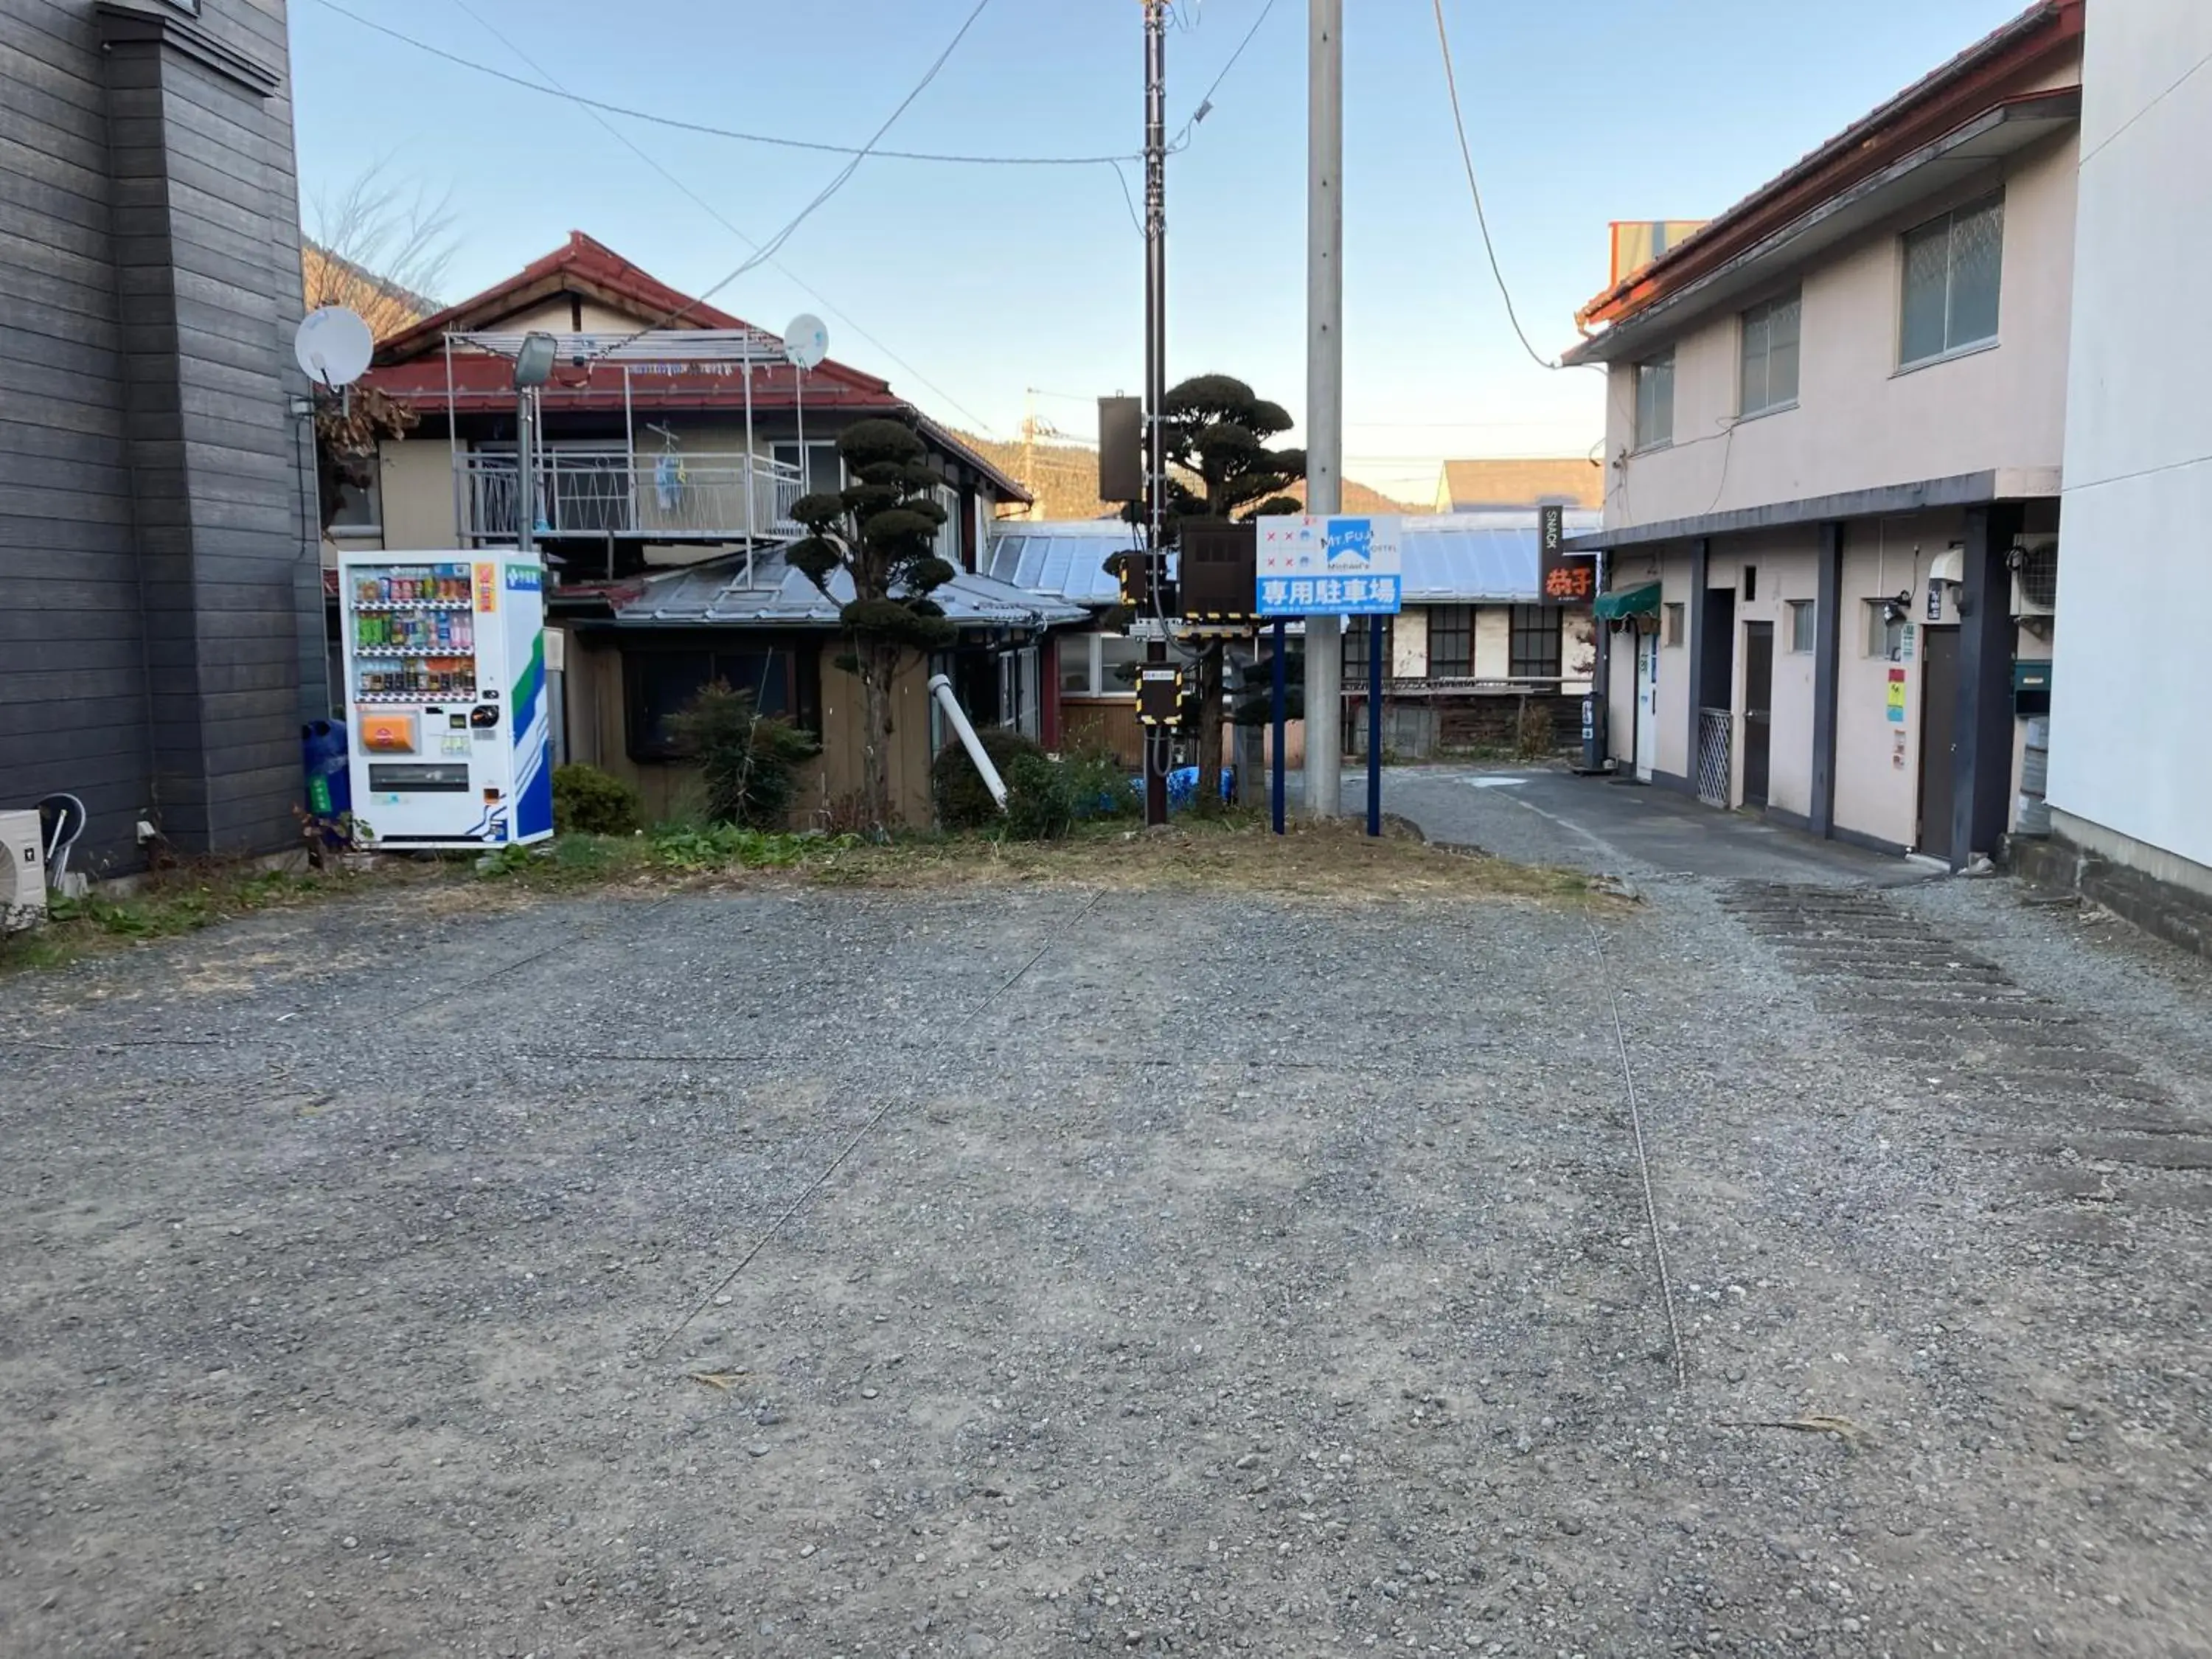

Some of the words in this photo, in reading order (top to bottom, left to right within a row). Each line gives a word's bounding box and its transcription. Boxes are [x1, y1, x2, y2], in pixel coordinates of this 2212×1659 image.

[1545, 510, 1557, 550] SNACK
[1262, 578, 1396, 605] 専用駐車場
